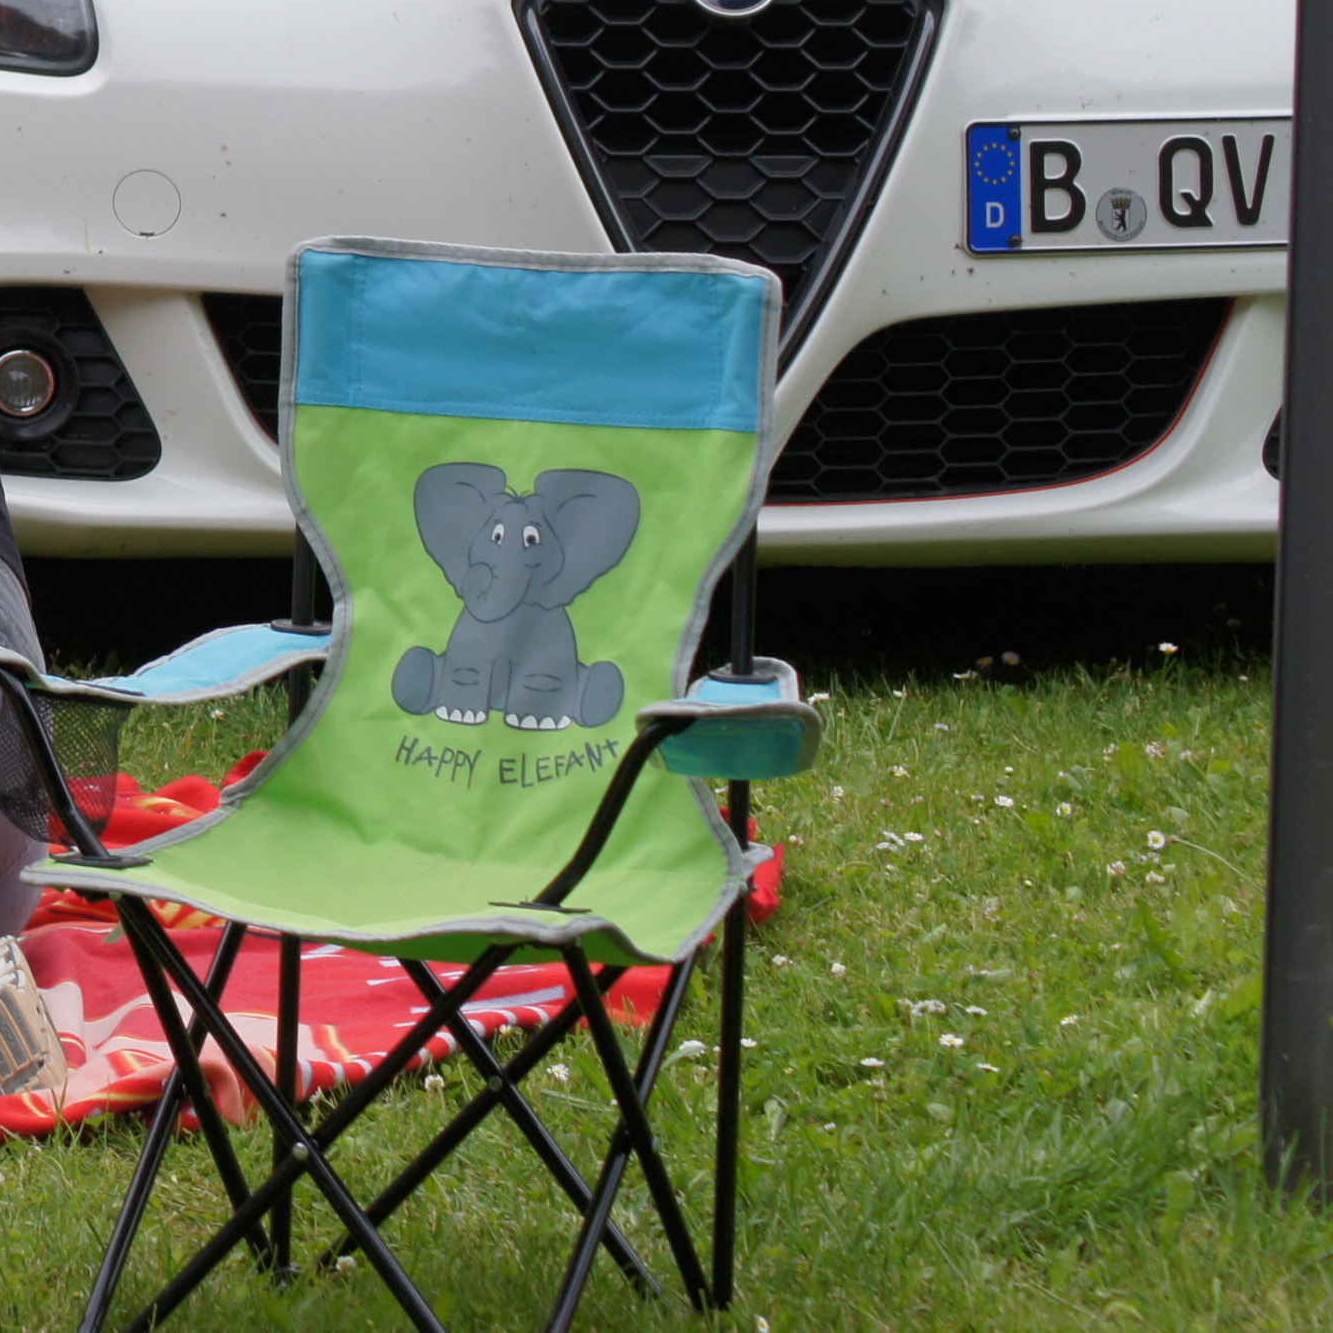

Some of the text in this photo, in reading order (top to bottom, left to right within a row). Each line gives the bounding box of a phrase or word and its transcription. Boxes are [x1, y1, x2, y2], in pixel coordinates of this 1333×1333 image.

[1029, 134, 1275, 233] B QV
[985, 202, 1005, 228] D
[395, 735, 620, 789] HAPPY ELEFANT
